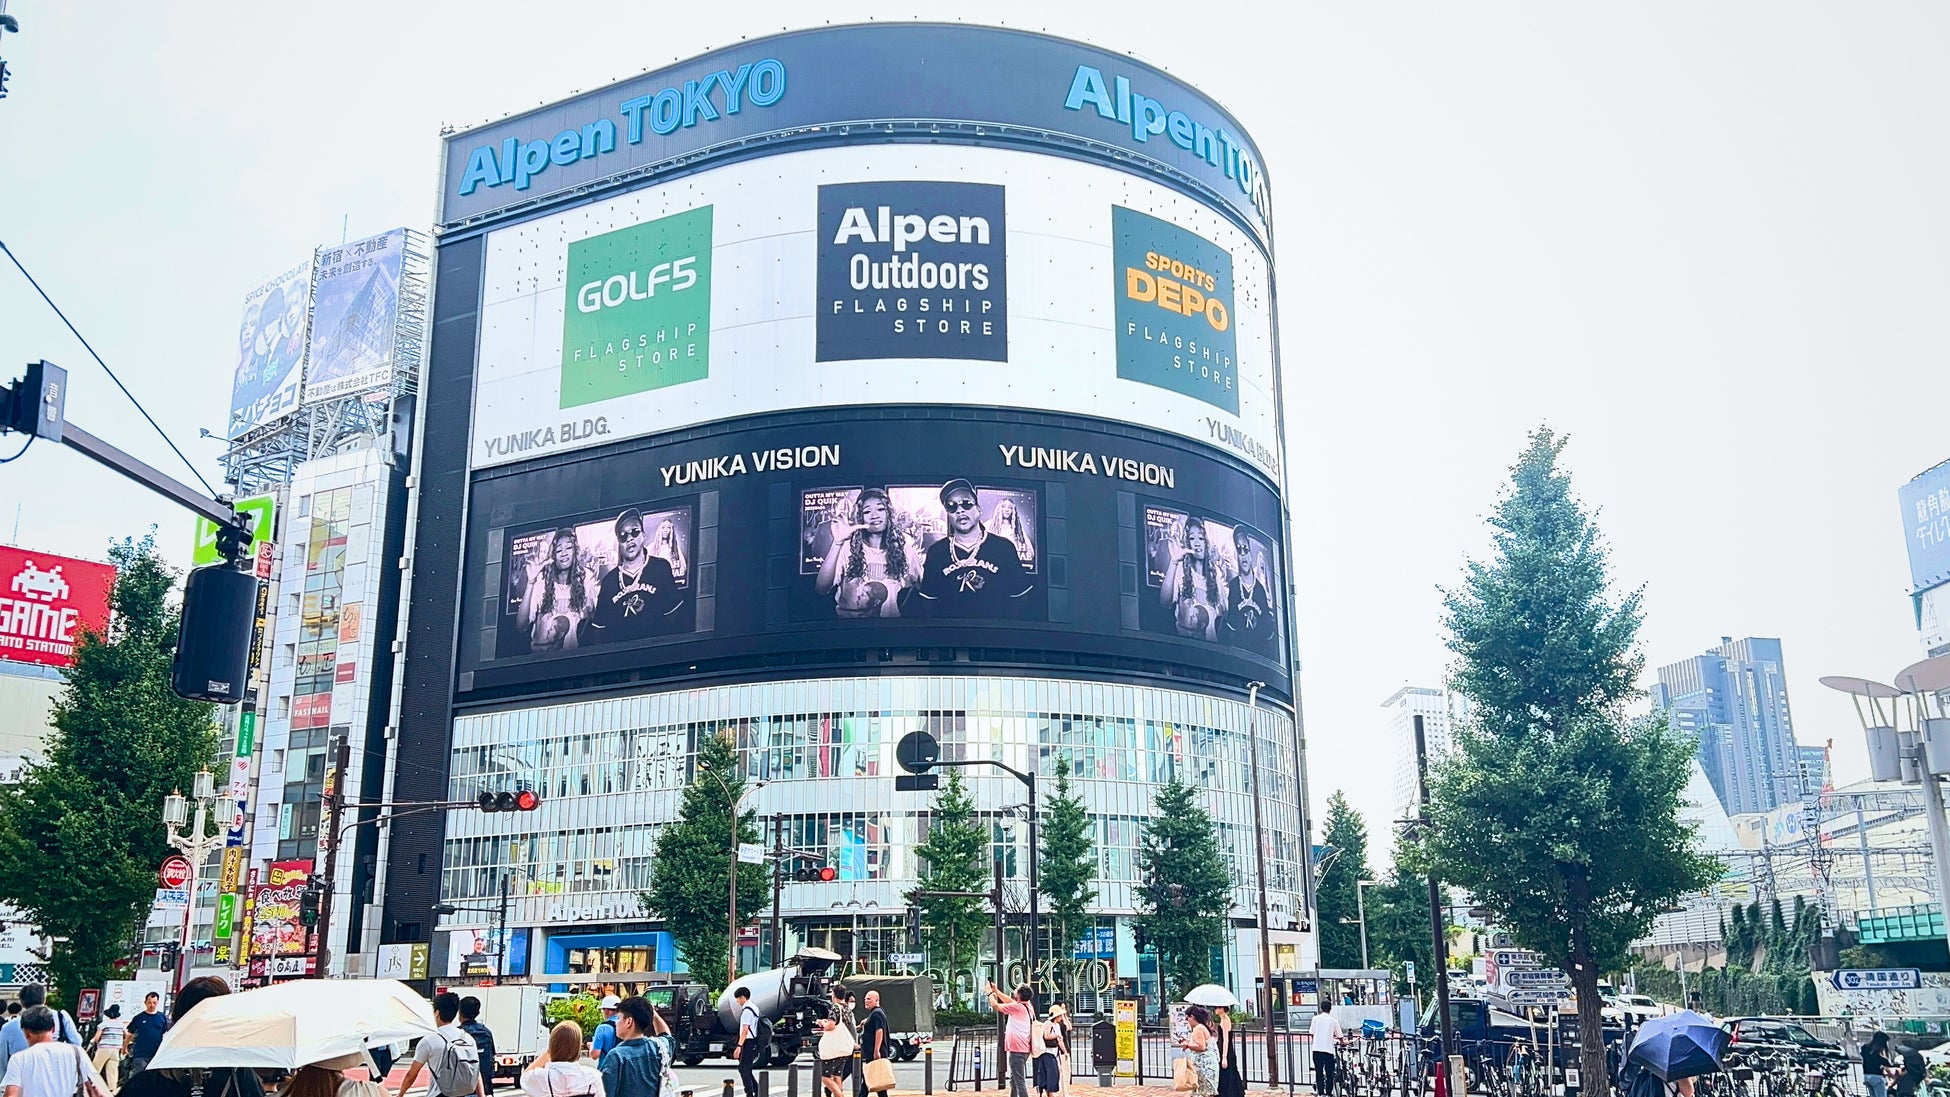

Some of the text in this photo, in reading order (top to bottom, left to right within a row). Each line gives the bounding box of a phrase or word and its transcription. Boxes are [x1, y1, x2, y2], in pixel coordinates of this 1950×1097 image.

[458, 58, 787, 196] Alpen TOKYO
[1064, 64, 1219, 168] Alpen
[833, 206, 990, 252] Alpen
[244, 260, 310, 305] SPICE CHOCOLATE
[577, 256, 697, 314] GOLF5
[850, 252, 989, 290] Outdoors
[1145, 251, 1215, 293] SPORTS
[833, 298, 992, 314] FLAGSHIP
[1126, 267, 1230, 332] DEPO
[574, 323, 696, 362] FLAGSHIP
[894, 319, 992, 335] STORE
[1128, 322, 1231, 369] FLAGSHIP
[618, 344, 695, 372] STORE
[1173, 356, 1232, 389] STORE
[484, 416, 611, 458] YUNIKA BLDG.
[1206, 417, 1256, 458] YUNIKA
[660, 444, 840, 487] YUNIKA VISION
[999, 444, 1175, 488] YUNIKA VISION
[817, 498, 838, 506] QUIK
[1157, 516, 1173, 524] QUIK
[0, 598, 78, 642] GAME
[26, 639, 73, 655] STATION
[219, 900, 231, 930] レイク
[549, 901, 605, 924] Alpen
[1845, 975, 1860, 985] 302
